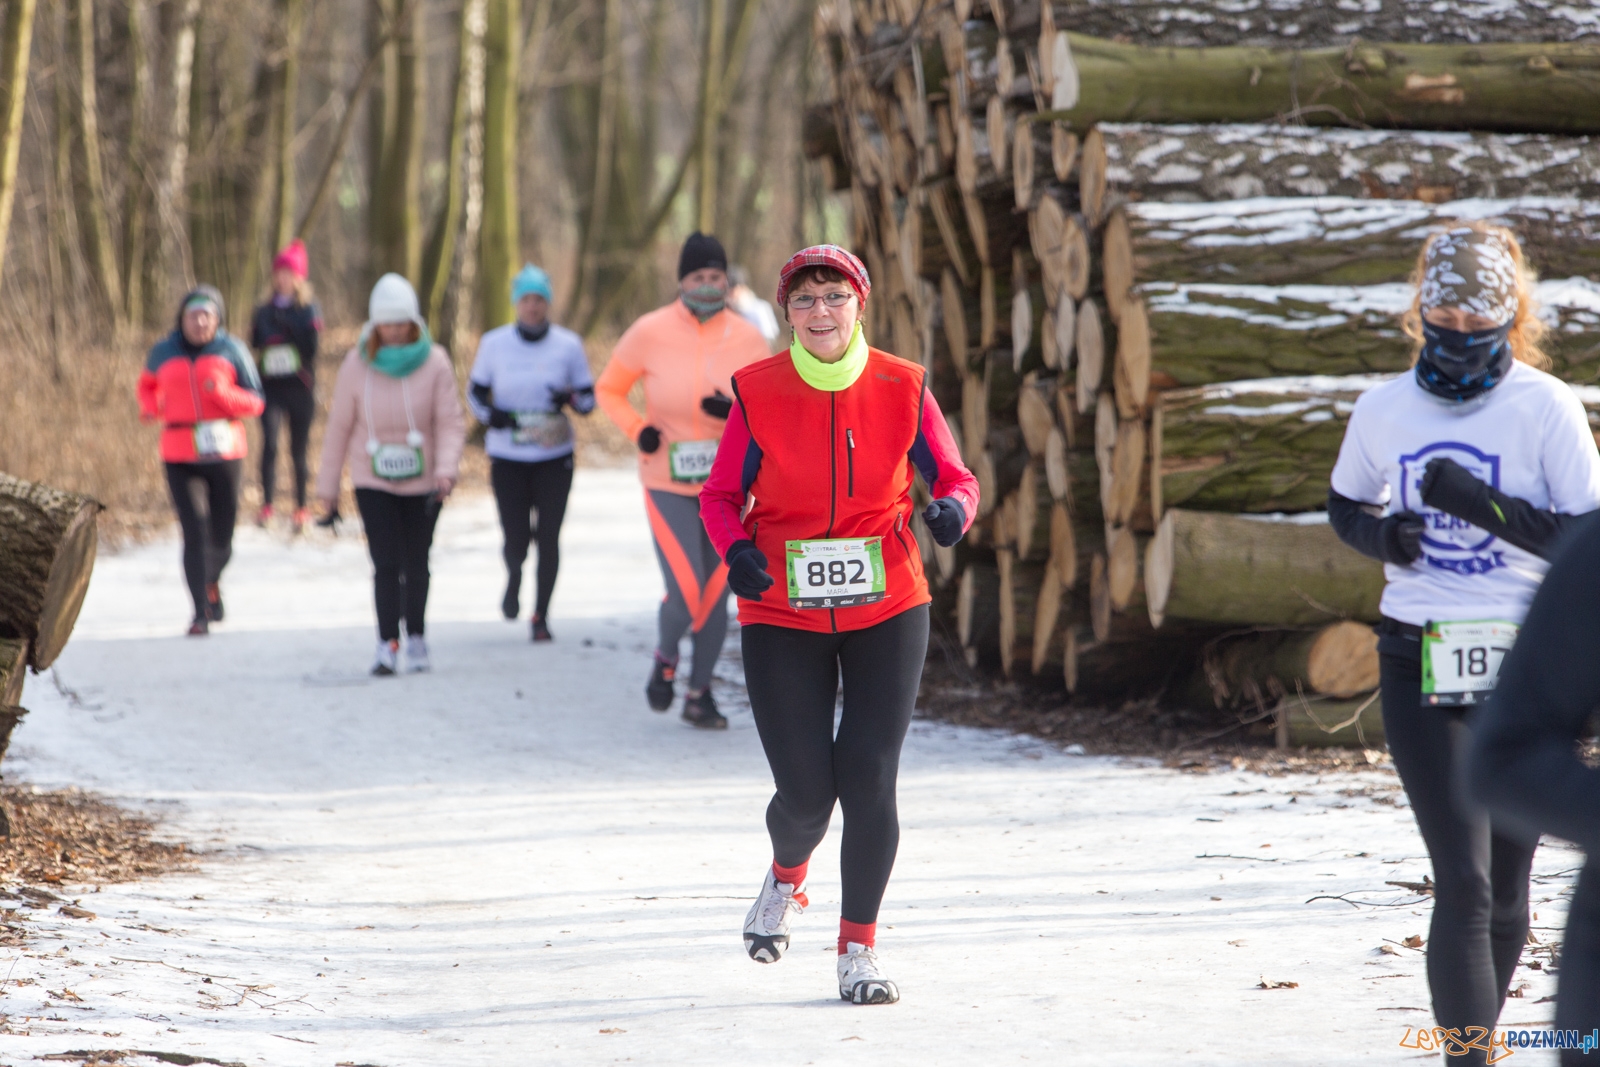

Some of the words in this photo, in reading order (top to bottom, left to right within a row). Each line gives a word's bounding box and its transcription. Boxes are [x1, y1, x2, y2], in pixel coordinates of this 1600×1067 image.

[1418, 513, 1471, 530] TEA
[807, 559, 866, 587] 882
[826, 588, 849, 596] MARIA
